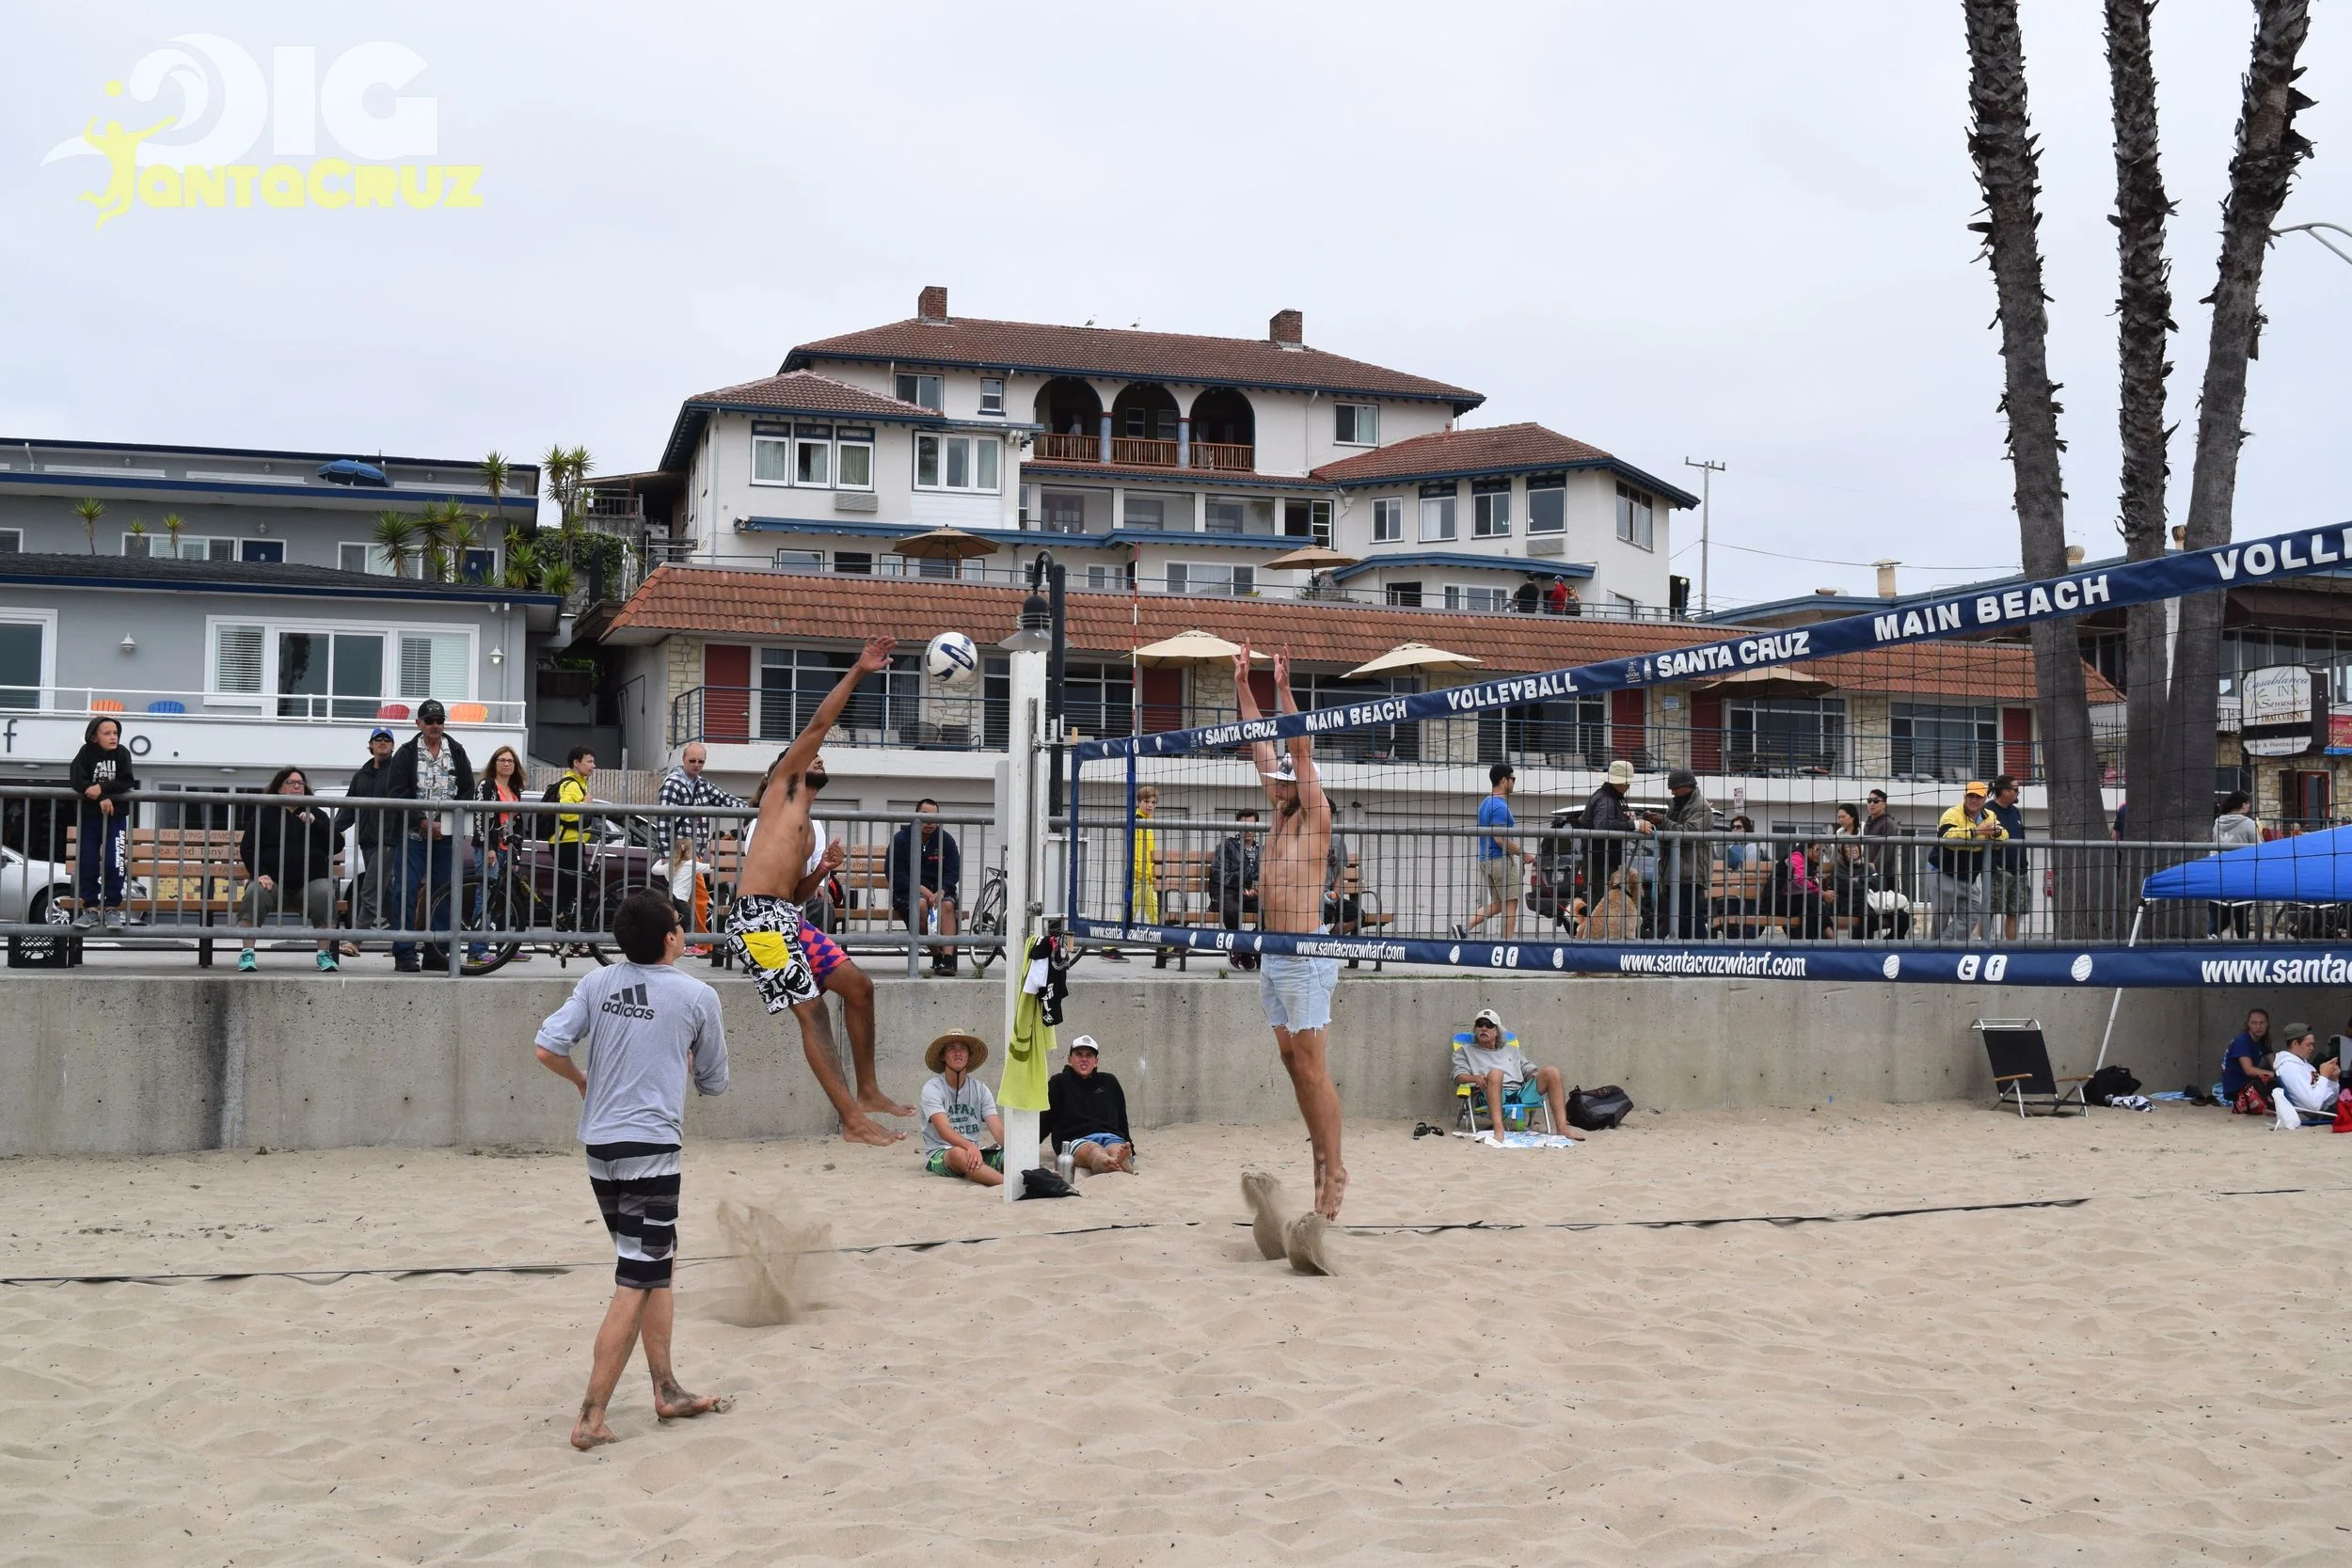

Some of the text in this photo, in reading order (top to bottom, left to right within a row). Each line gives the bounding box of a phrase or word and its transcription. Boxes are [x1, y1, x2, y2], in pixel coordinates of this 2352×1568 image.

[1657, 645, 1736, 677] SANTA
[1739, 631, 1811, 665] CRUZ
[1874, 602, 1962, 641] MAIN
[1977, 575, 2110, 624] BEACH
[2278, 685, 2298, 697] INN
[1205, 724, 1242, 746] SANTA
[1243, 720, 1279, 740] CRUZ
[1306, 709, 1344, 732] MAIN
[1350, 700, 1407, 725] BEACH
[1446, 673, 1579, 710] VOLLEYBALL
[1295, 940, 1406, 961] www.santacruzwharf.com
[1620, 951, 1806, 976] www.santacruzwharf.com
[602, 1002, 656, 1021] adidas
